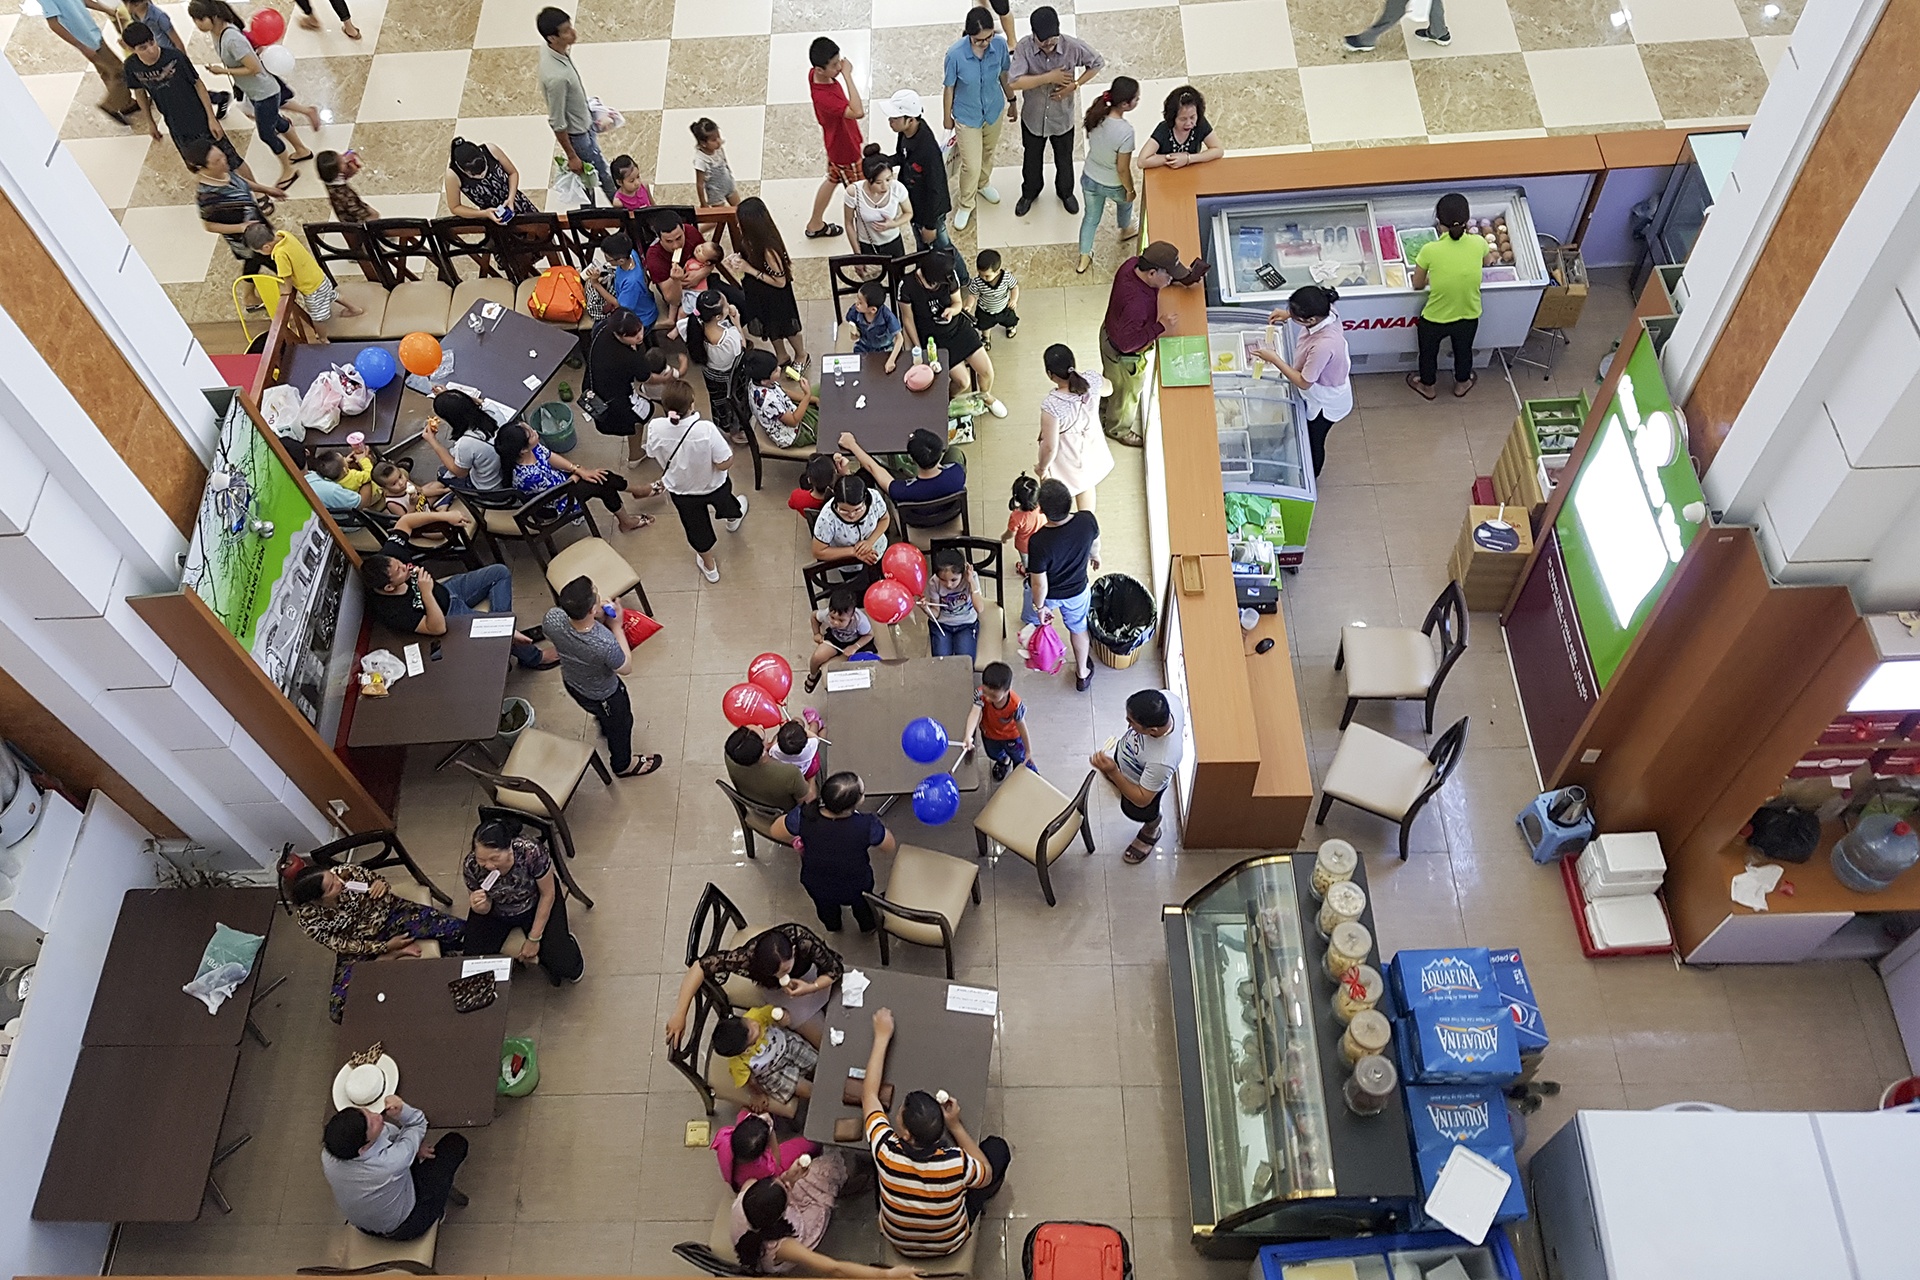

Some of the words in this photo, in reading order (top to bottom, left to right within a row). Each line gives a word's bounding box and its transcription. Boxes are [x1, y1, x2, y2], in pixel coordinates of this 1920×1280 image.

[1421, 965, 1483, 993] AQUAFINA
[1434, 1026, 1498, 1054] AQUAFINA
[1426, 1101, 1489, 1132] AQUAFINA
